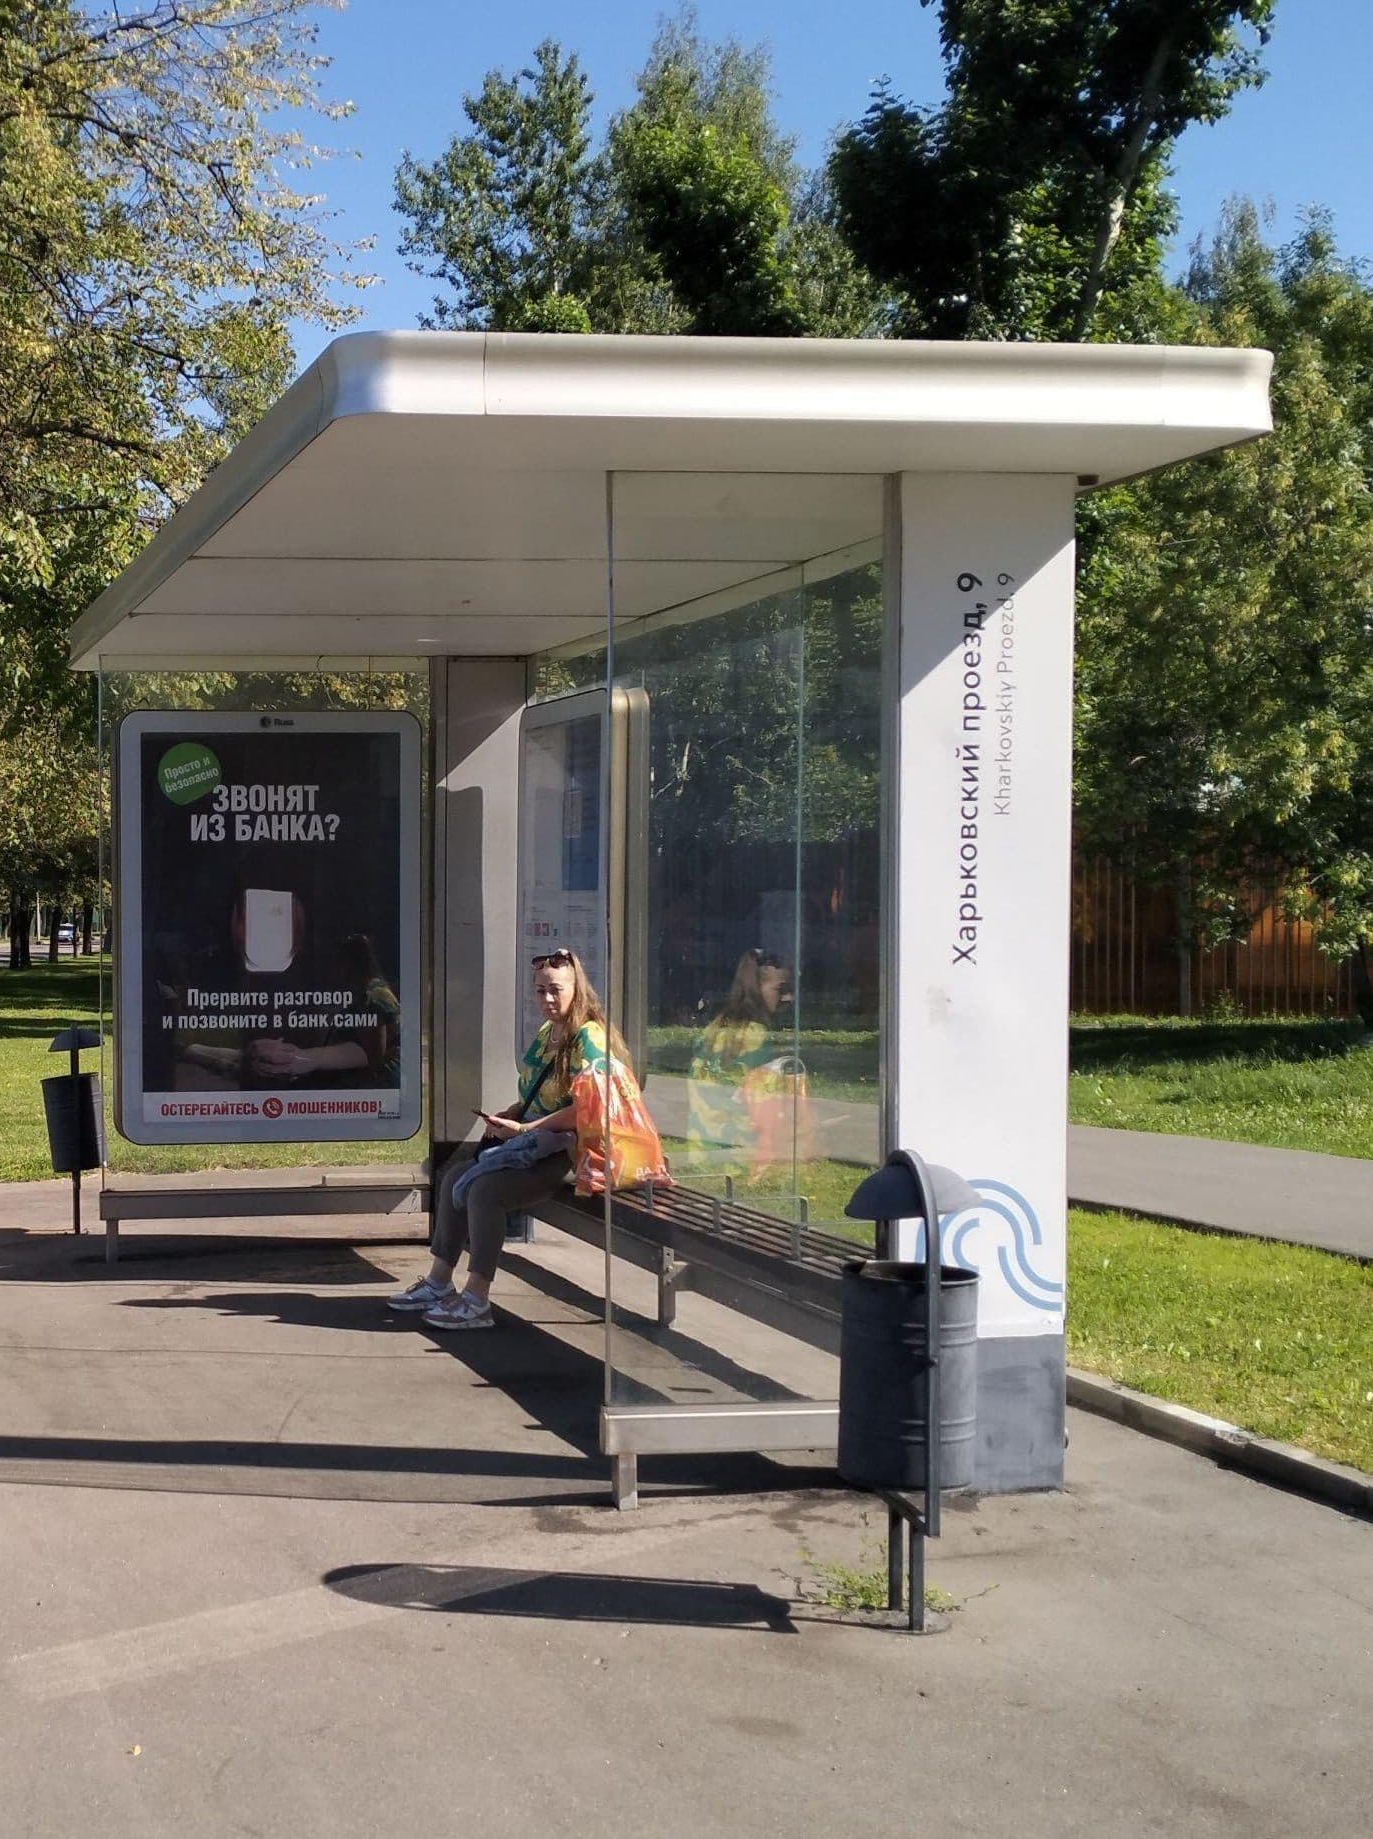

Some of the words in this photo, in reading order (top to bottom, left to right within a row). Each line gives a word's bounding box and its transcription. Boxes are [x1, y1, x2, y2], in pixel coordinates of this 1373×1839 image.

[956, 571, 983, 592] 9
[997, 571, 1016, 586] 9
[995, 592, 1017, 674] Proezd,
[961, 601, 988, 732] проезд,
[993, 678, 1017, 816] Kharkovskiy
[164, 760, 201, 779] Просто
[164, 767, 219, 793] безопасно
[212, 784, 320, 812] ЗВОНЯТ
[190, 814, 226, 841] ИЗ
[235, 813, 340, 841] БАНКА?
[952, 744, 983, 966] Харьковский
[187, 988, 269, 1009] Прервите
[274, 990, 353, 1008] разговор
[162, 1015, 173, 1029] и
[178, 1014, 267, 1029] позвоните
[274, 1014, 283, 1028] в
[288, 1012, 329, 1028] банк
[334, 1014, 378, 1027] сами
[161, 1101, 260, 1116] ОСТЕРЕГАЙТЕСЬ
[287, 1100, 382, 1114] МОШЕННИКОВ!
